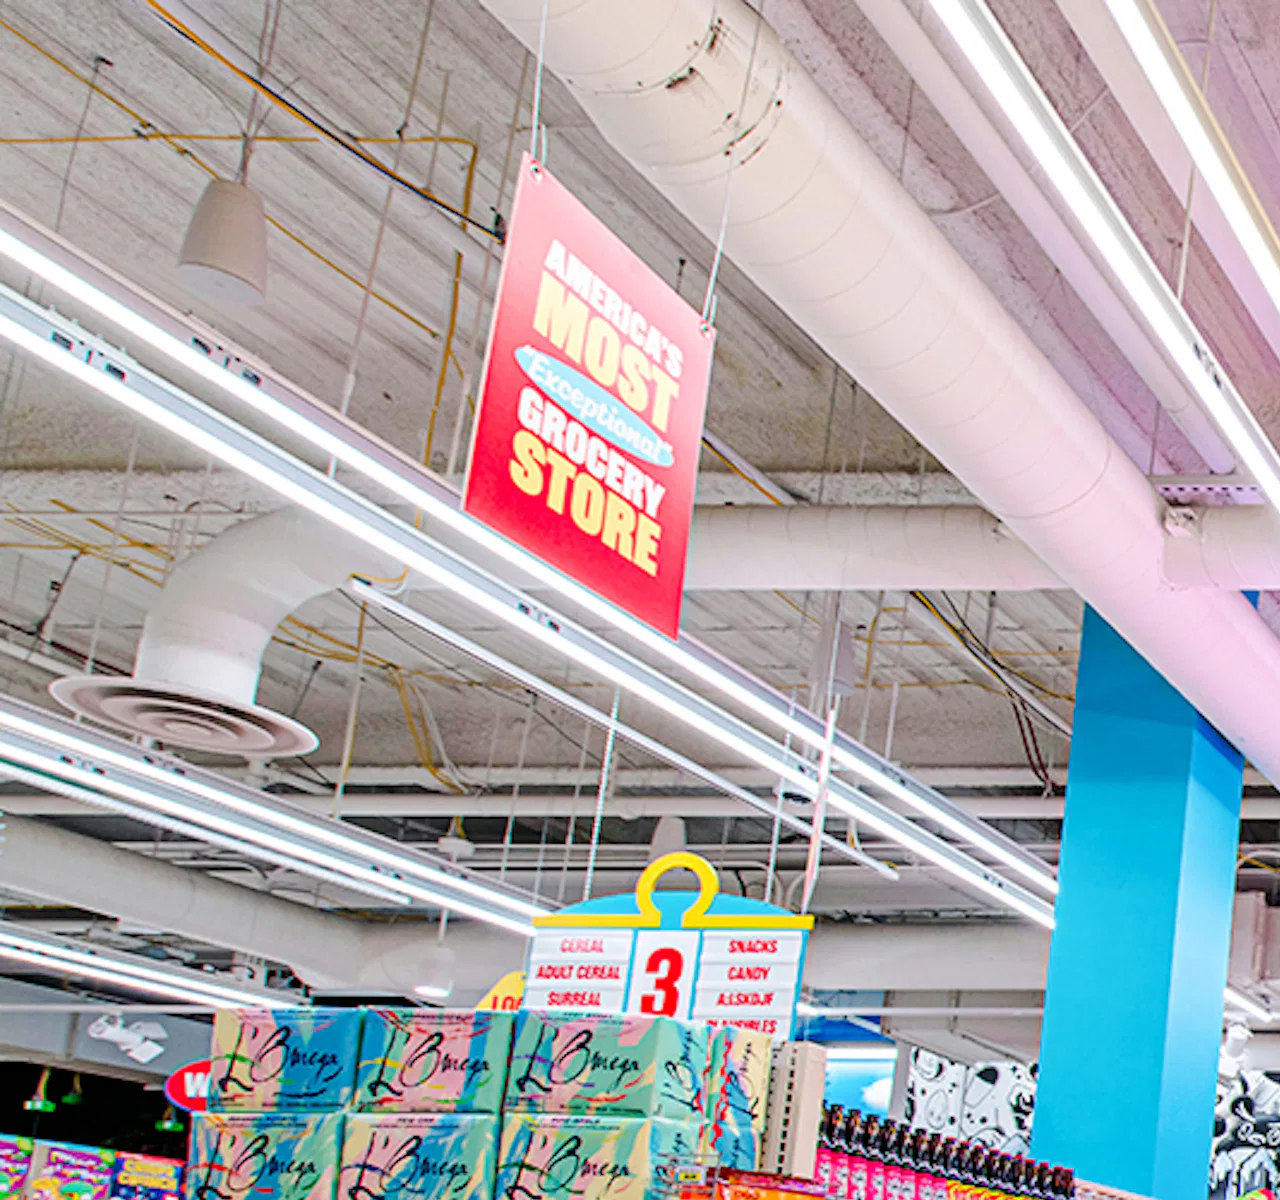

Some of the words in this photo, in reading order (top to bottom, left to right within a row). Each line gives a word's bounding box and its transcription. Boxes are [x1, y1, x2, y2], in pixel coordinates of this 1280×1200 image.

[544, 239, 684, 379] AMERICA'S
[533, 270, 680, 433] MOST
[518, 387, 665, 518] GROCERY
[509, 430, 662, 577] STORE
[560, 938, 604, 954] CEREAL
[729, 940, 778, 954] SNACKS
[536, 965, 573, 980] ADULT
[576, 965, 620, 980] CEREAL
[640, 948, 684, 1017] 3
[728, 966, 771, 980] CANDY
[547, 992, 601, 1007] SURREAL
